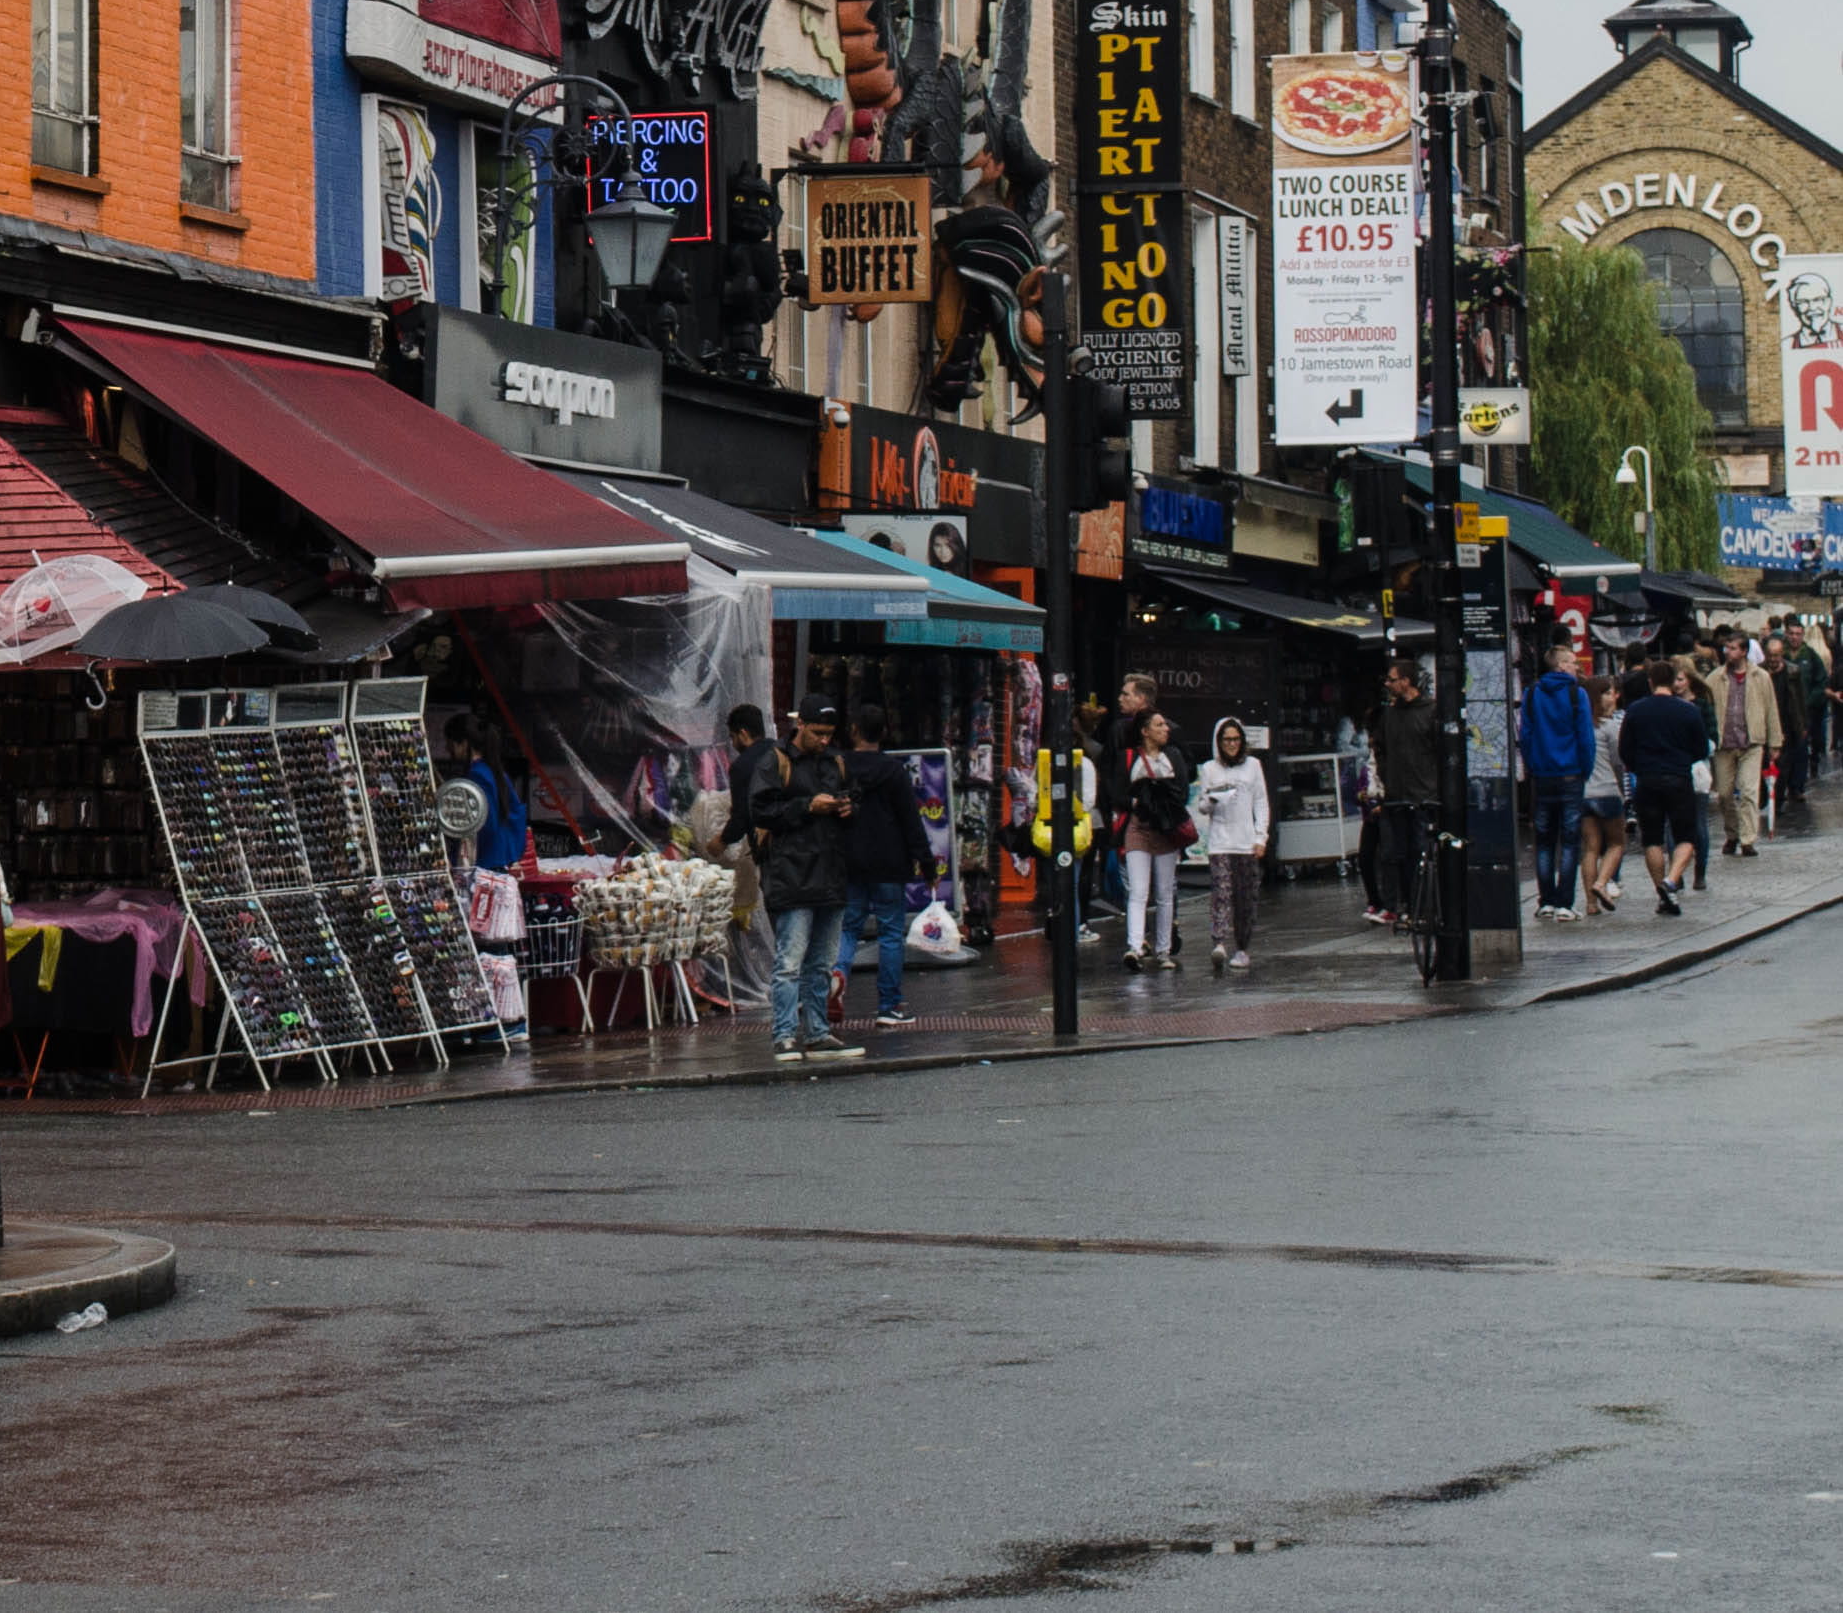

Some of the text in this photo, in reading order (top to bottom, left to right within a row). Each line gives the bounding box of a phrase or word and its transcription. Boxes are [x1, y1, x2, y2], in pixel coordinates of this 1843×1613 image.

[1088, 1, 1168, 32] Skin
[592, 119, 705, 145] PIERCING
[640, 148, 658, 173] &
[600, 178, 698, 204] TTOO
[1097, 33, 1138, 329] PIERCING
[1132, 37, 1167, 329] TATTOO
[1278, 173, 1407, 196] TWO COURSE
[1279, 196, 1409, 218] LUNCH DEAL!
[1559, 173, 1697, 245] MDEN
[821, 200, 918, 240] ORIENTAL
[821, 245, 918, 293] BUFFET
[1279, 258, 1301, 270] Add
[1304, 261, 1311, 270] a
[1313, 257, 1338, 269] third
[1341, 260, 1376, 269] course
[1378, 256, 1393, 268] for
[1286, 275, 1323, 287] Monday
[1331, 274, 1360, 285] Friday
[1083, 332, 1182, 349] FULLY LICENCED
[1226, 305, 1245, 370] Metal
[1293, 326, 1397, 344] ROSSOPOMODORO
[1085, 365, 1184, 383] ODY JEWELLERY
[1280, 354, 1413, 371] 10 Jamestown Road
[1327, 373, 1357, 383] minute
[505, 361, 616, 426] scorpion
[1148, 398, 1182, 411] 4305
[1794, 446, 1811, 467] 2
[1720, 525, 1797, 559] CAMDEN
